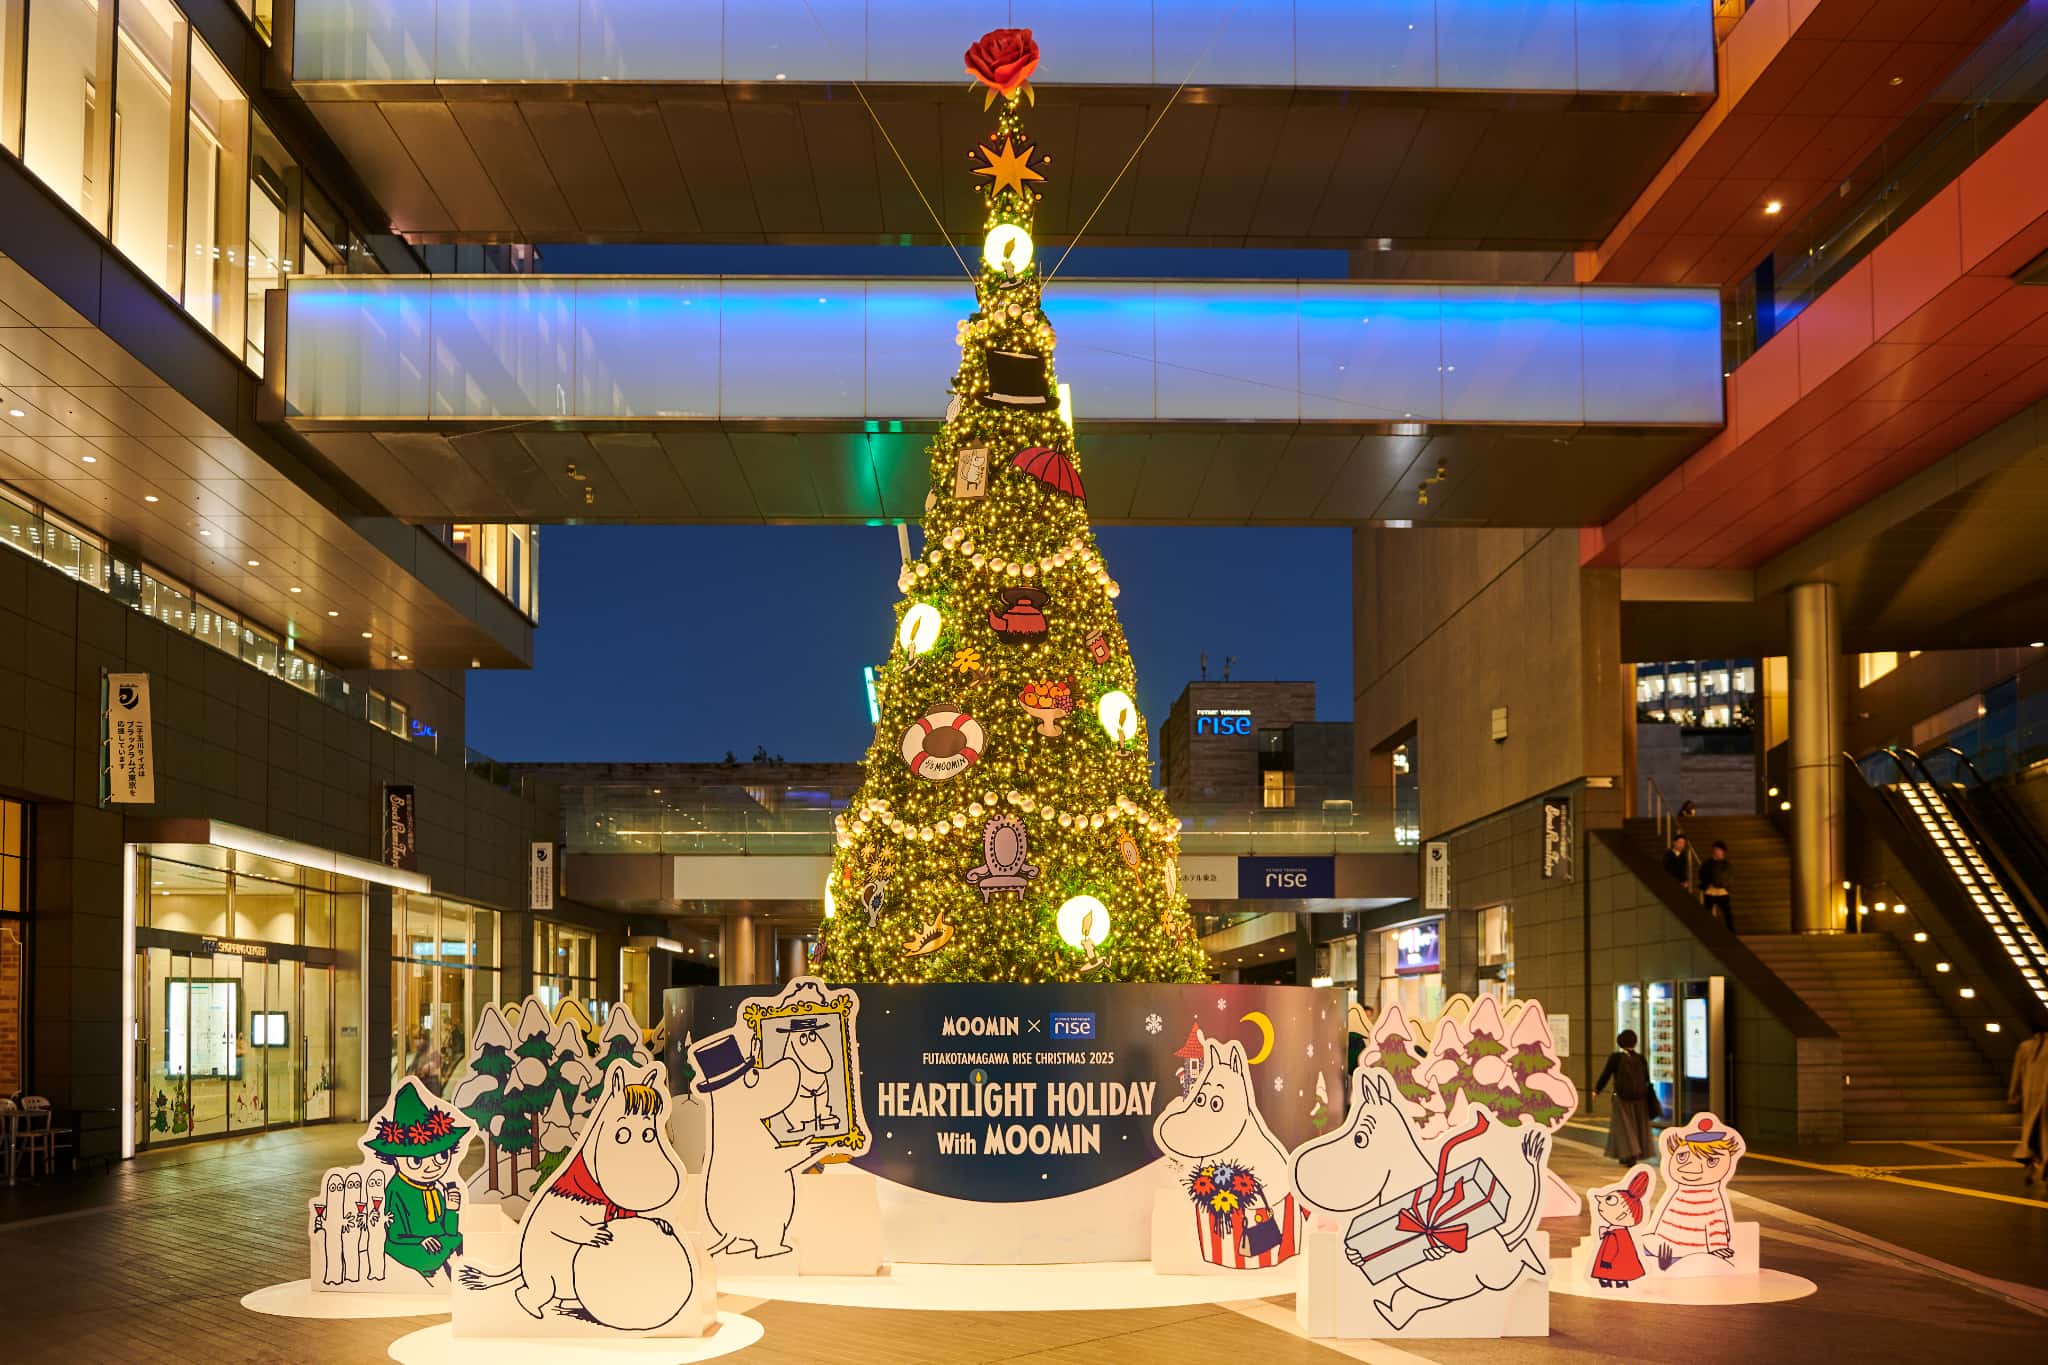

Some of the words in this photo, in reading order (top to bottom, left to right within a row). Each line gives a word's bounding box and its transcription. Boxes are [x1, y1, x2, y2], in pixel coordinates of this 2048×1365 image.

[1197, 716, 1251, 736] rise
[934, 758, 966, 772] MOOMIN
[1265, 873, 1308, 888] rise
[942, 1015, 1019, 1037] MOOMIN
[1054, 1022, 1091, 1035] rise
[922, 1052, 1010, 1065] FUTAKOTAMAGAWA
[1012, 1052, 1032, 1065] RISE
[1035, 1051, 1086, 1065] CHRISTMAS
[1089, 1051, 1115, 1065] 2025
[877, 1081, 1038, 1118] HEARTLIGHT
[1047, 1080, 1157, 1117] HOLIDAY
[937, 1130, 977, 1156] With
[983, 1122, 1101, 1156] MOOMIN
